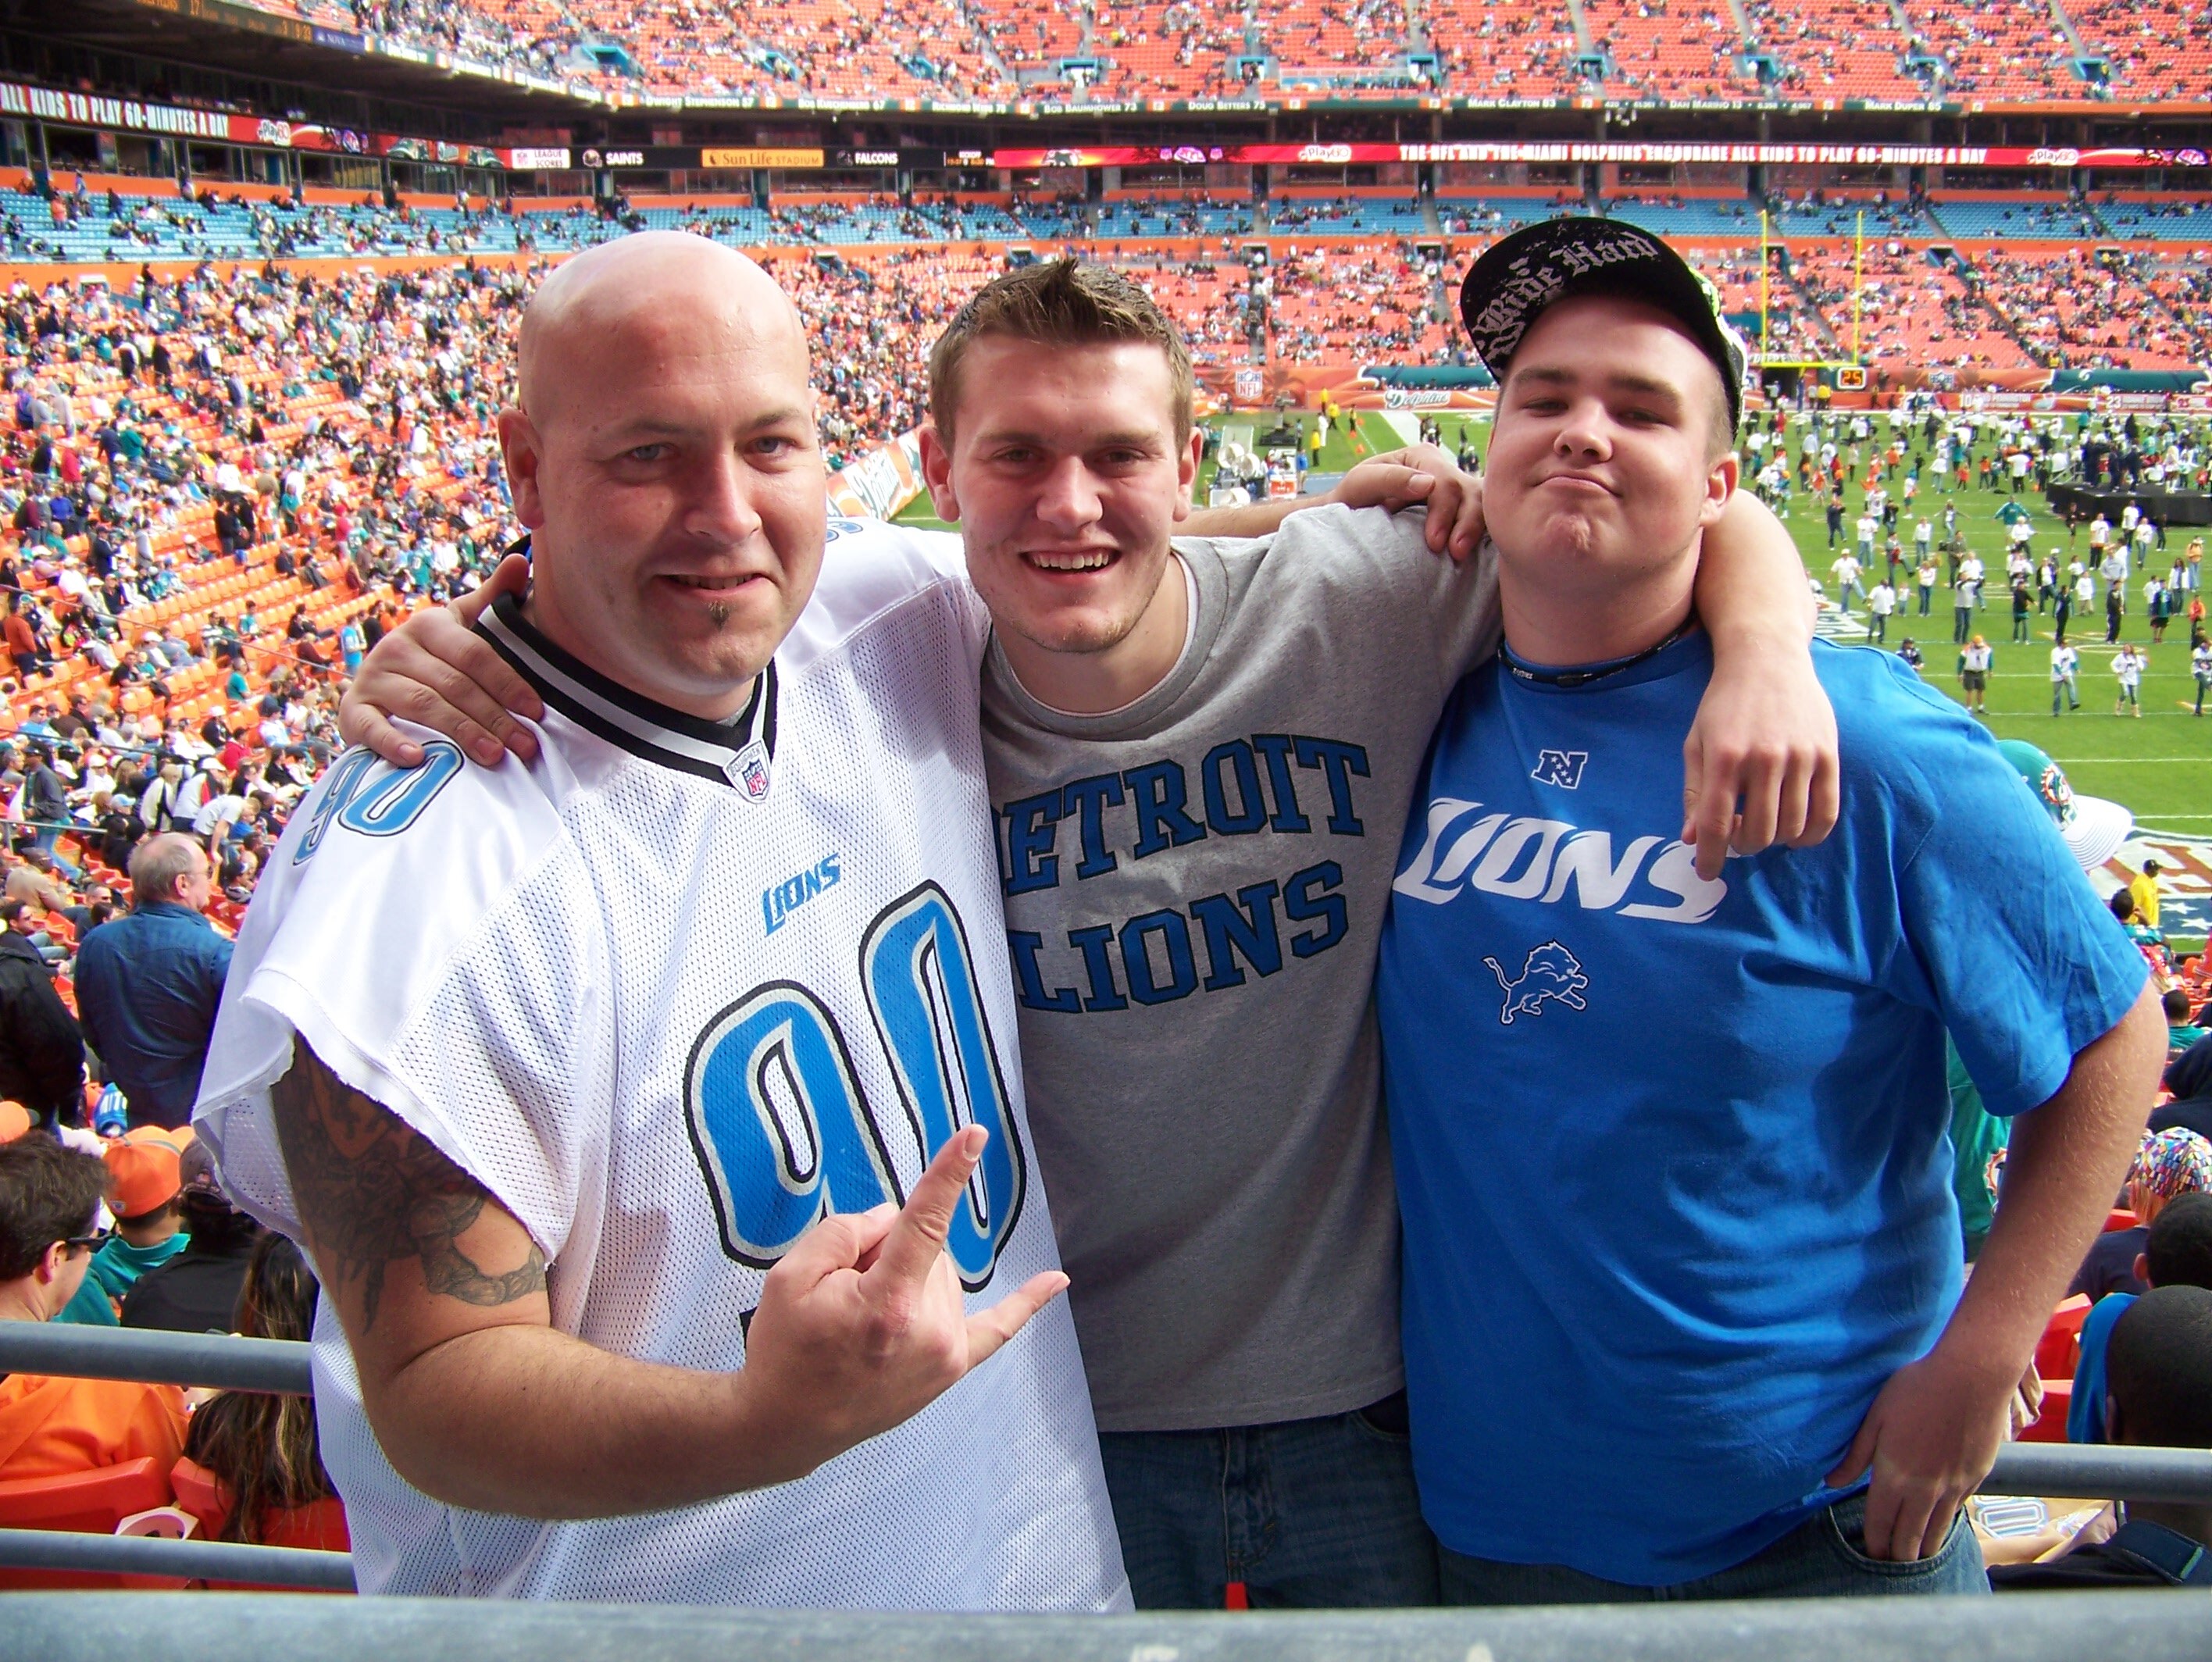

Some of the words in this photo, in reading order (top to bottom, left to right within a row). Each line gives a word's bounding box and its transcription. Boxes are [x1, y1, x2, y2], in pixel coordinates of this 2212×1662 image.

[30, 86, 68, 119] KIDS
[68, 91, 88, 123] TO
[89, 95, 123, 127] PLAY
[198, 110, 208, 137] A
[209, 112, 230, 139] DAY
[605, 151, 644, 166] SAINTS
[722, 153, 747, 165] Sun
[750, 152, 772, 165] Life
[776, 156, 819, 165] STADIUM
[854, 151, 898, 165] FALCONS
[1960, 148, 1988, 163] DAY
[1842, 370, 1862, 386] 25
[1386, 391, 1450, 409] Dolphins
[749, 772, 766, 794] NFL
[293, 740, 465, 866] 90
[990, 733, 1372, 897] ETROIT
[1392, 797, 1742, 924] LIONS
[762, 851, 841, 937] LIONS
[1007, 859, 1350, 1013] LIONS
